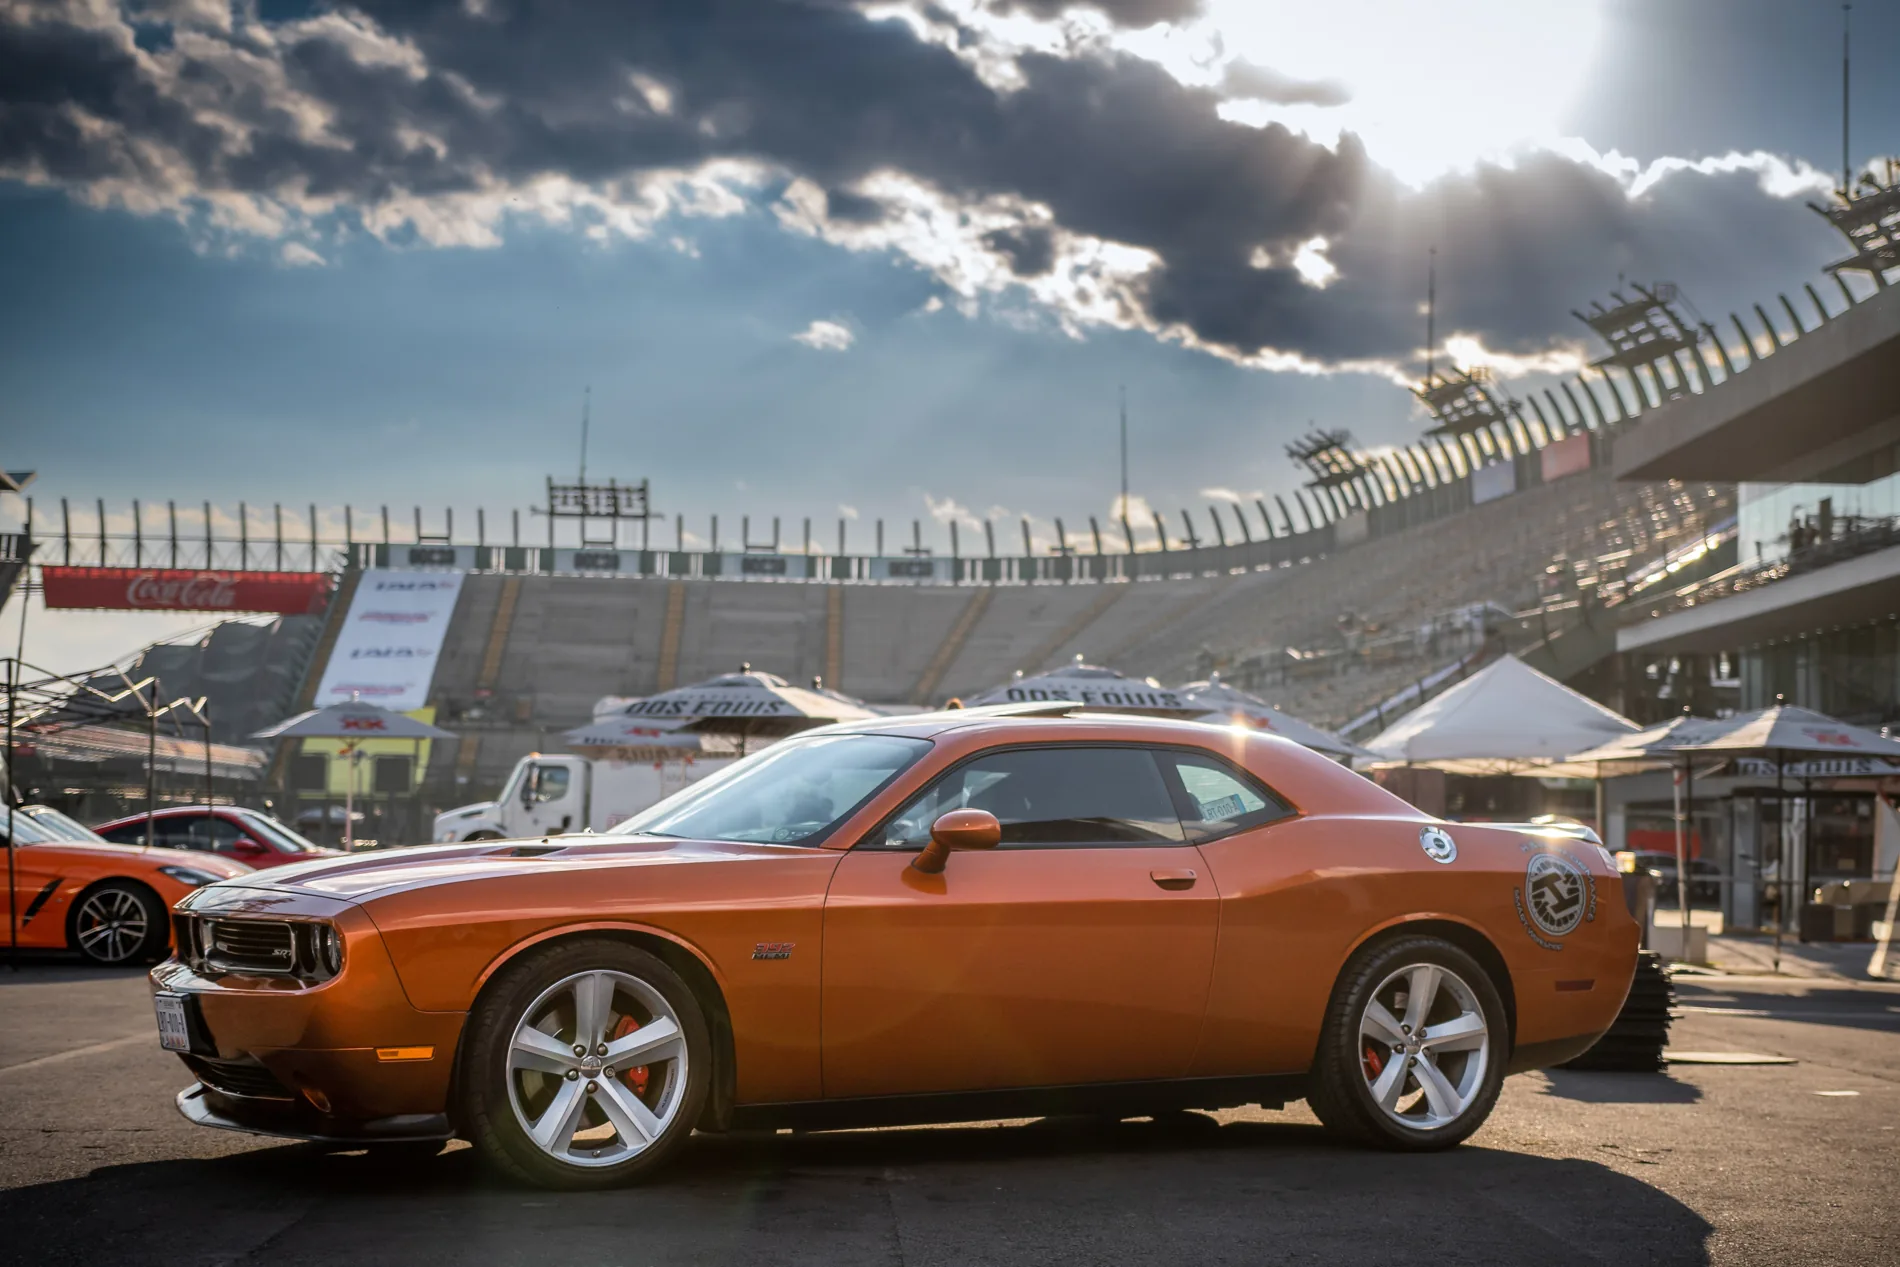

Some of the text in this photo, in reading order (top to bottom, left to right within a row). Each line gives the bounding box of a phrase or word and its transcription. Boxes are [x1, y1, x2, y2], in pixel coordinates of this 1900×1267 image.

[1006, 688, 1070, 702] DOS
[624, 701, 688, 715] DOS
[756, 942, 796, 953] 392
